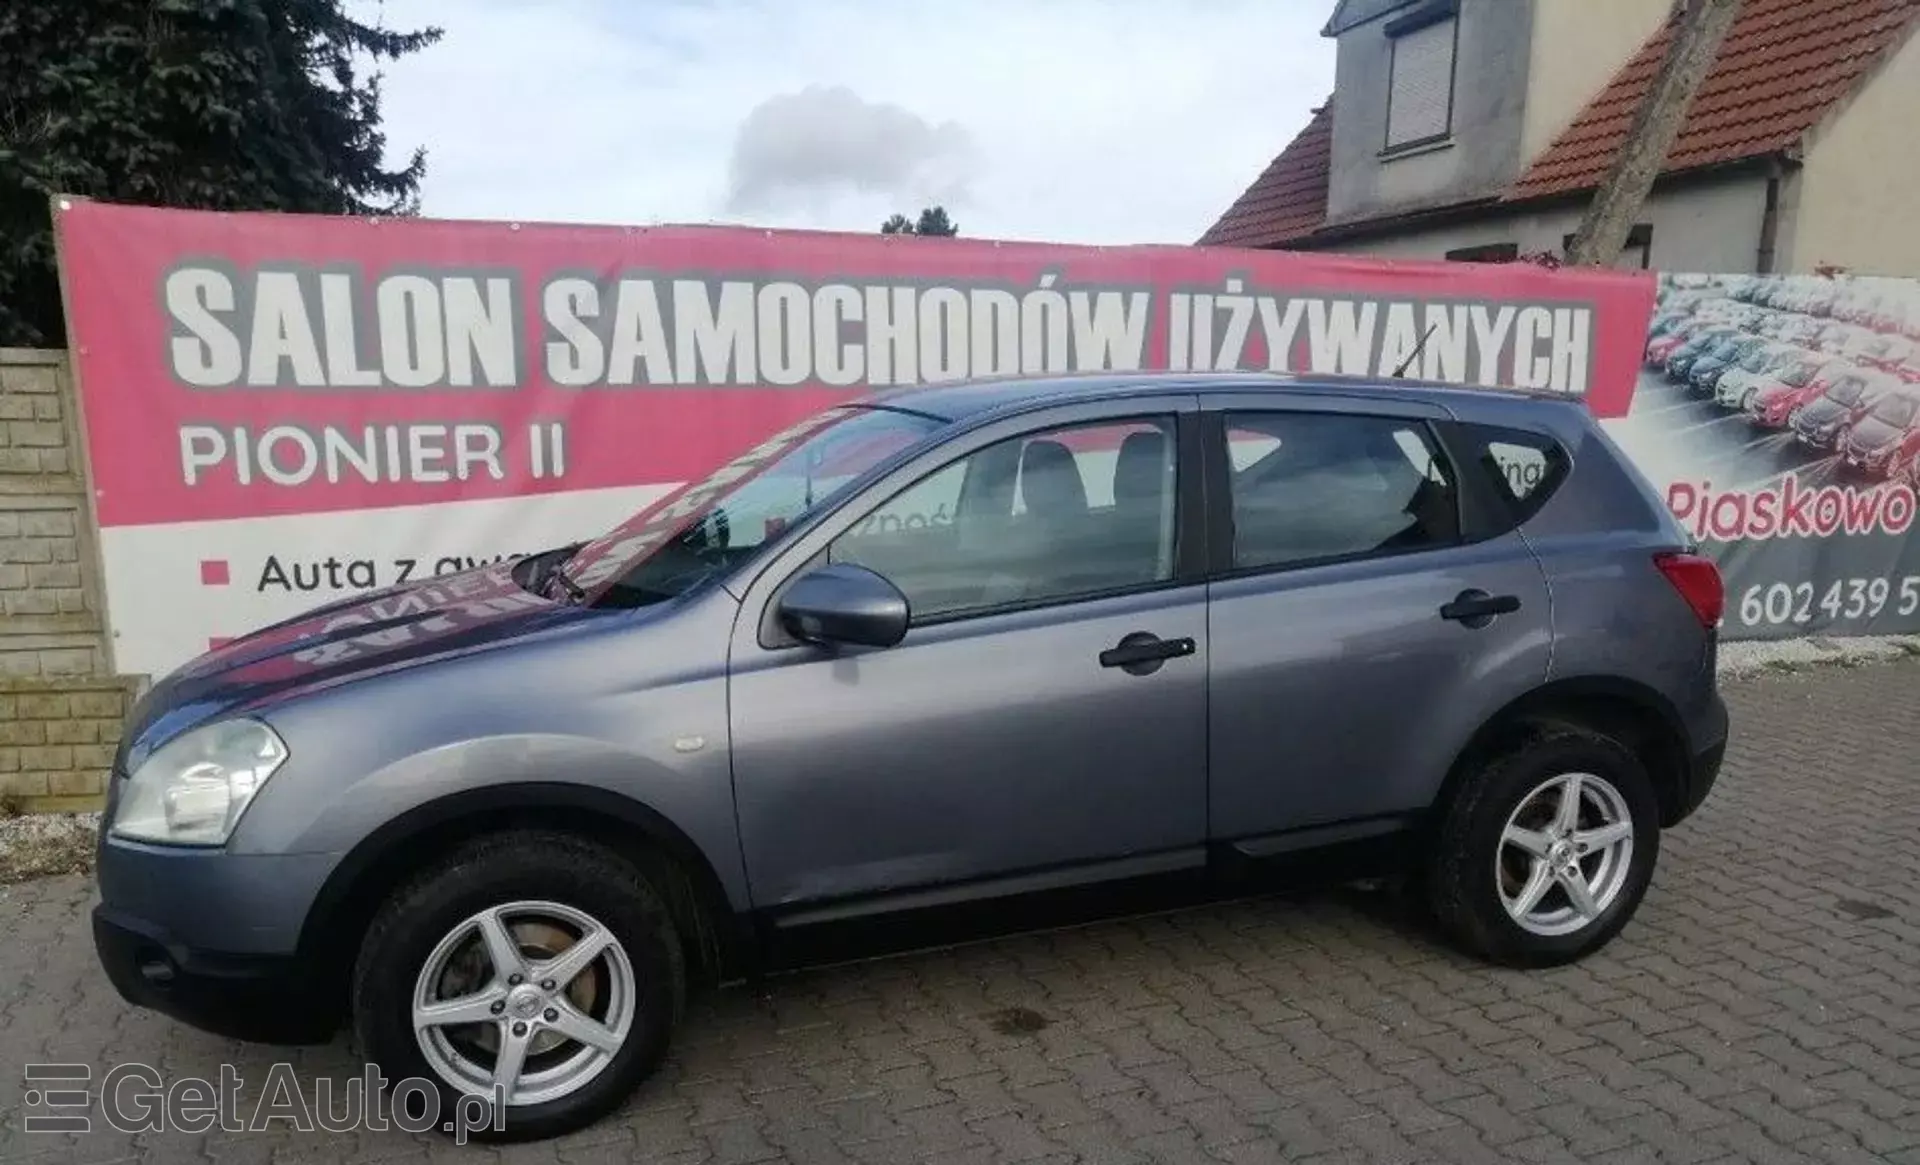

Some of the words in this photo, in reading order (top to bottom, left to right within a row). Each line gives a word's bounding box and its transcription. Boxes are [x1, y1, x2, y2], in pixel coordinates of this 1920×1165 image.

[166, 268, 517, 389] SALON
[541, 274, 1150, 387] SAMOCHODÓW
[1169, 278, 1591, 394] UŻYWANYCH
[178, 422, 504, 486] PIONIER
[529, 422, 565, 479] II
[1667, 473, 1916, 541] Piaskowo
[257, 555, 377, 592] Auta
[394, 558, 417, 585] z
[1740, 582, 1815, 626] 602
[1820, 577, 1890, 619] 439
[1897, 576, 1920, 616] 5
